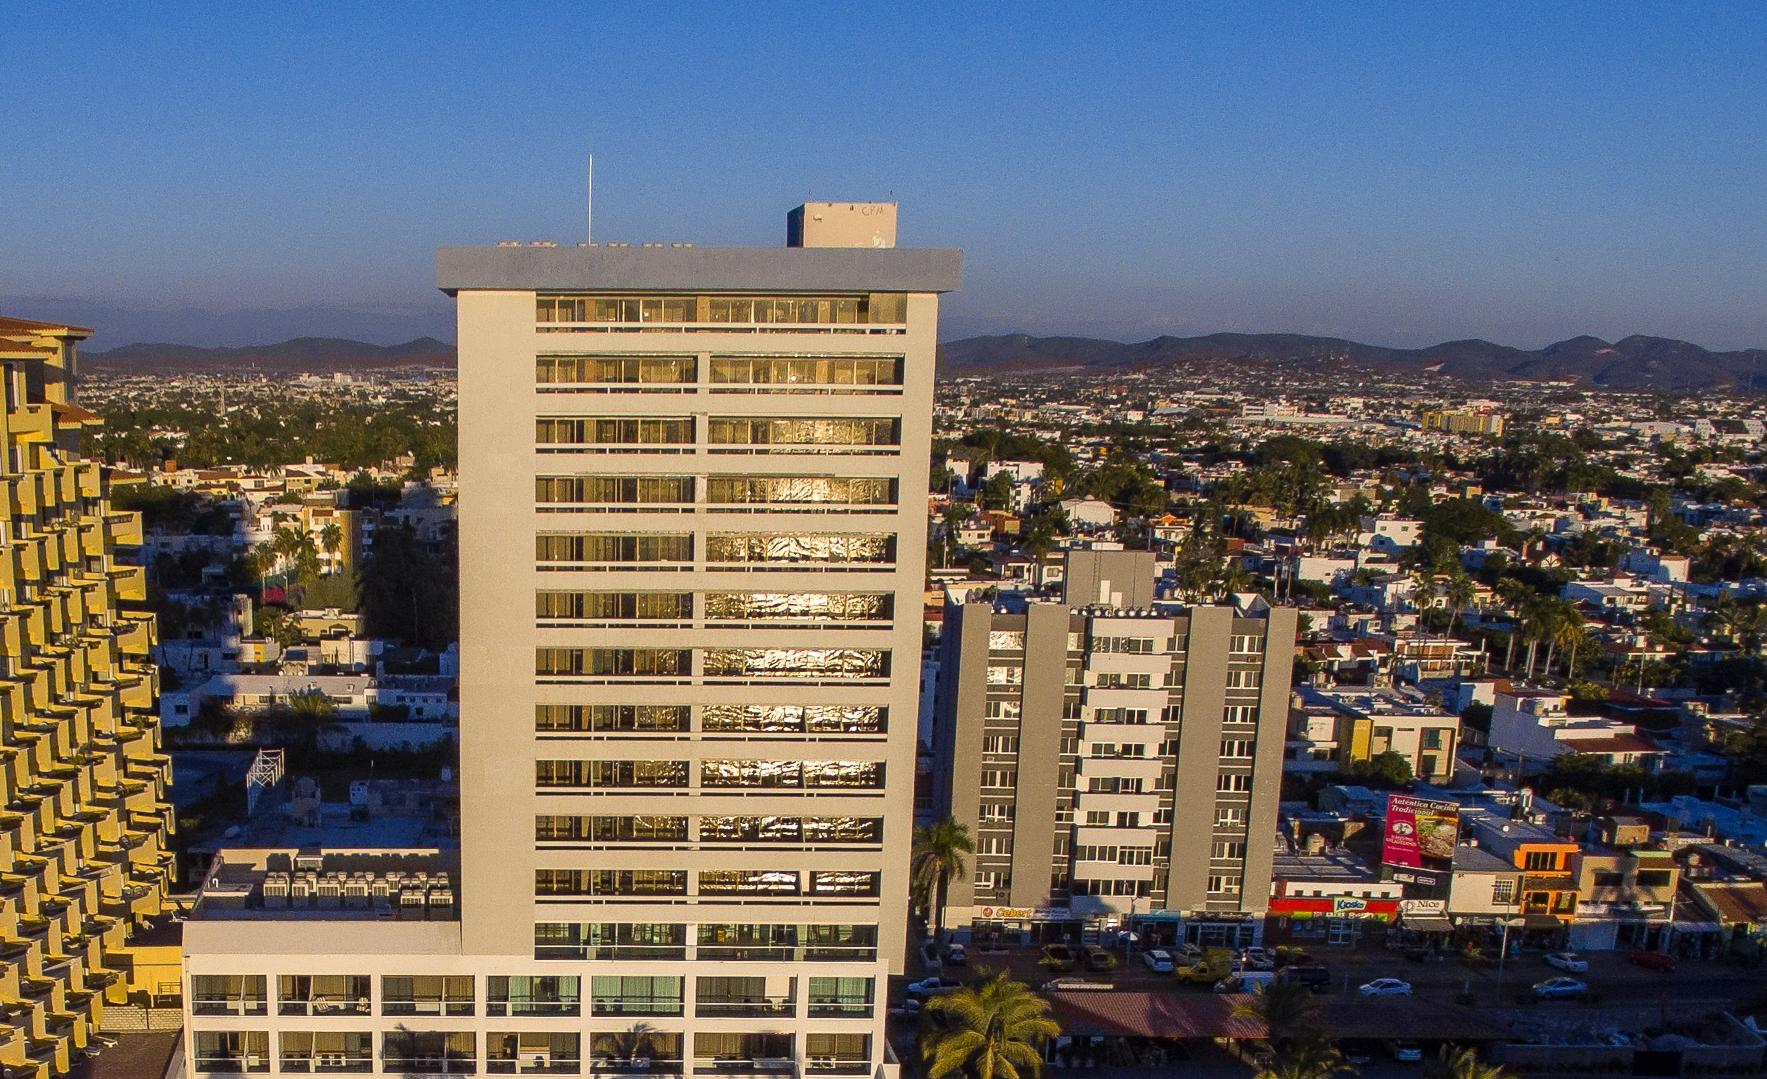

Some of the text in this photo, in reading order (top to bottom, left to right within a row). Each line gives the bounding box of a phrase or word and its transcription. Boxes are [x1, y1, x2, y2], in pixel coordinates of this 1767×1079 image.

[1391, 804, 1435, 816] Tradicional
[1336, 899, 1364, 909] Kiosko
[1416, 900, 1440, 908] Nice
